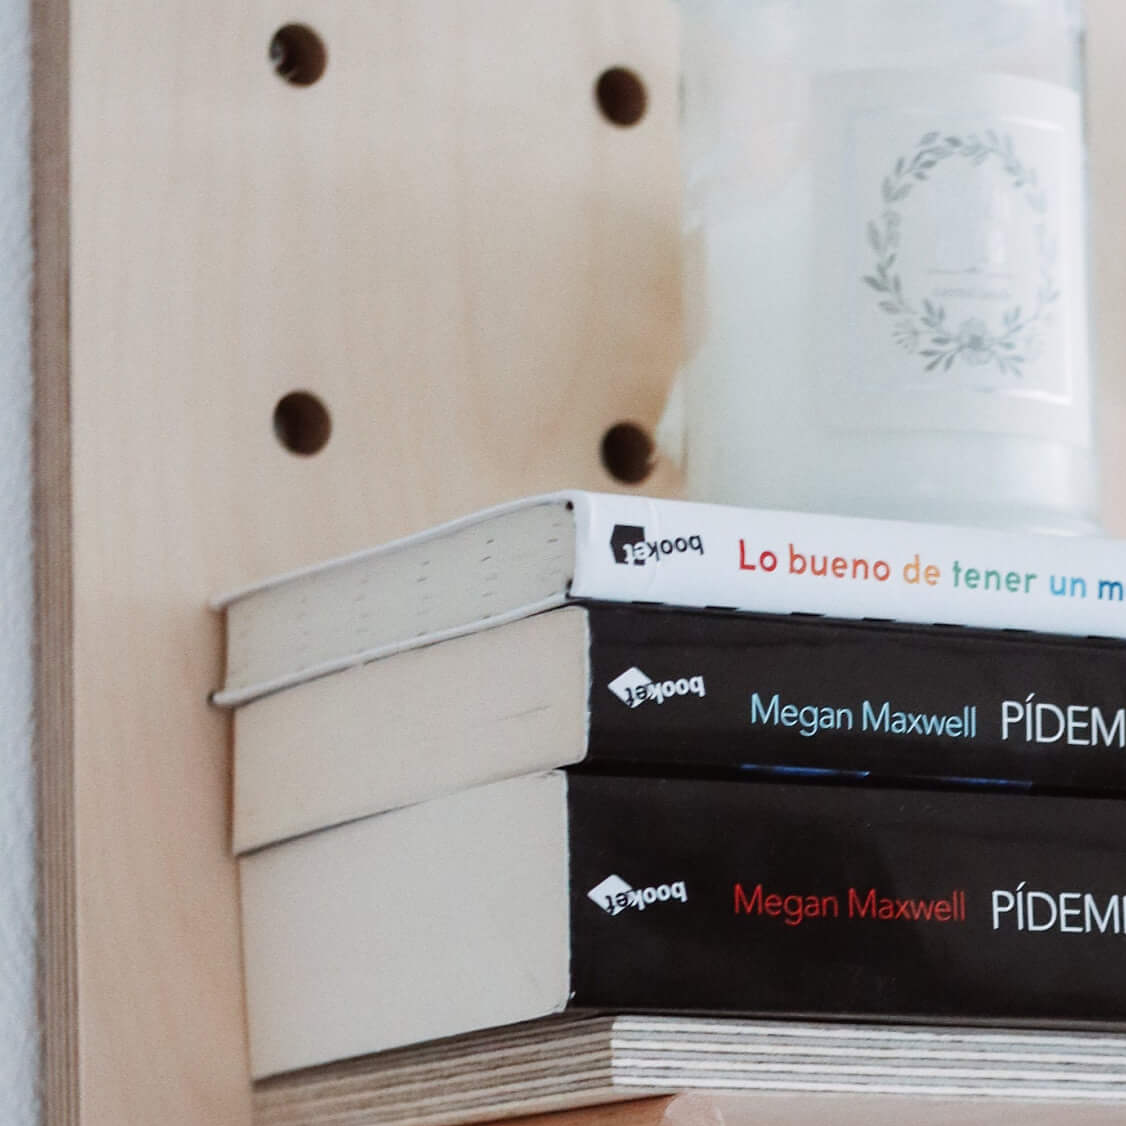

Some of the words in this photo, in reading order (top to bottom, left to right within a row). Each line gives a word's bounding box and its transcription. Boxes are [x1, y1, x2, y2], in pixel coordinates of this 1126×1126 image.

[622, 534, 705, 565] booket
[739, 539, 777, 572] Lo
[789, 544, 890, 581] bueno
[903, 555, 940, 585] de
[952, 560, 1037, 593] tener
[1050, 576, 1086, 598] un
[624, 675, 706, 708] booket
[752, 693, 852, 736] Megan
[863, 701, 976, 737] Maxwell
[604, 880, 688, 916] booket
[734, 884, 838, 926] Megan
[849, 888, 965, 921] Maxwell
